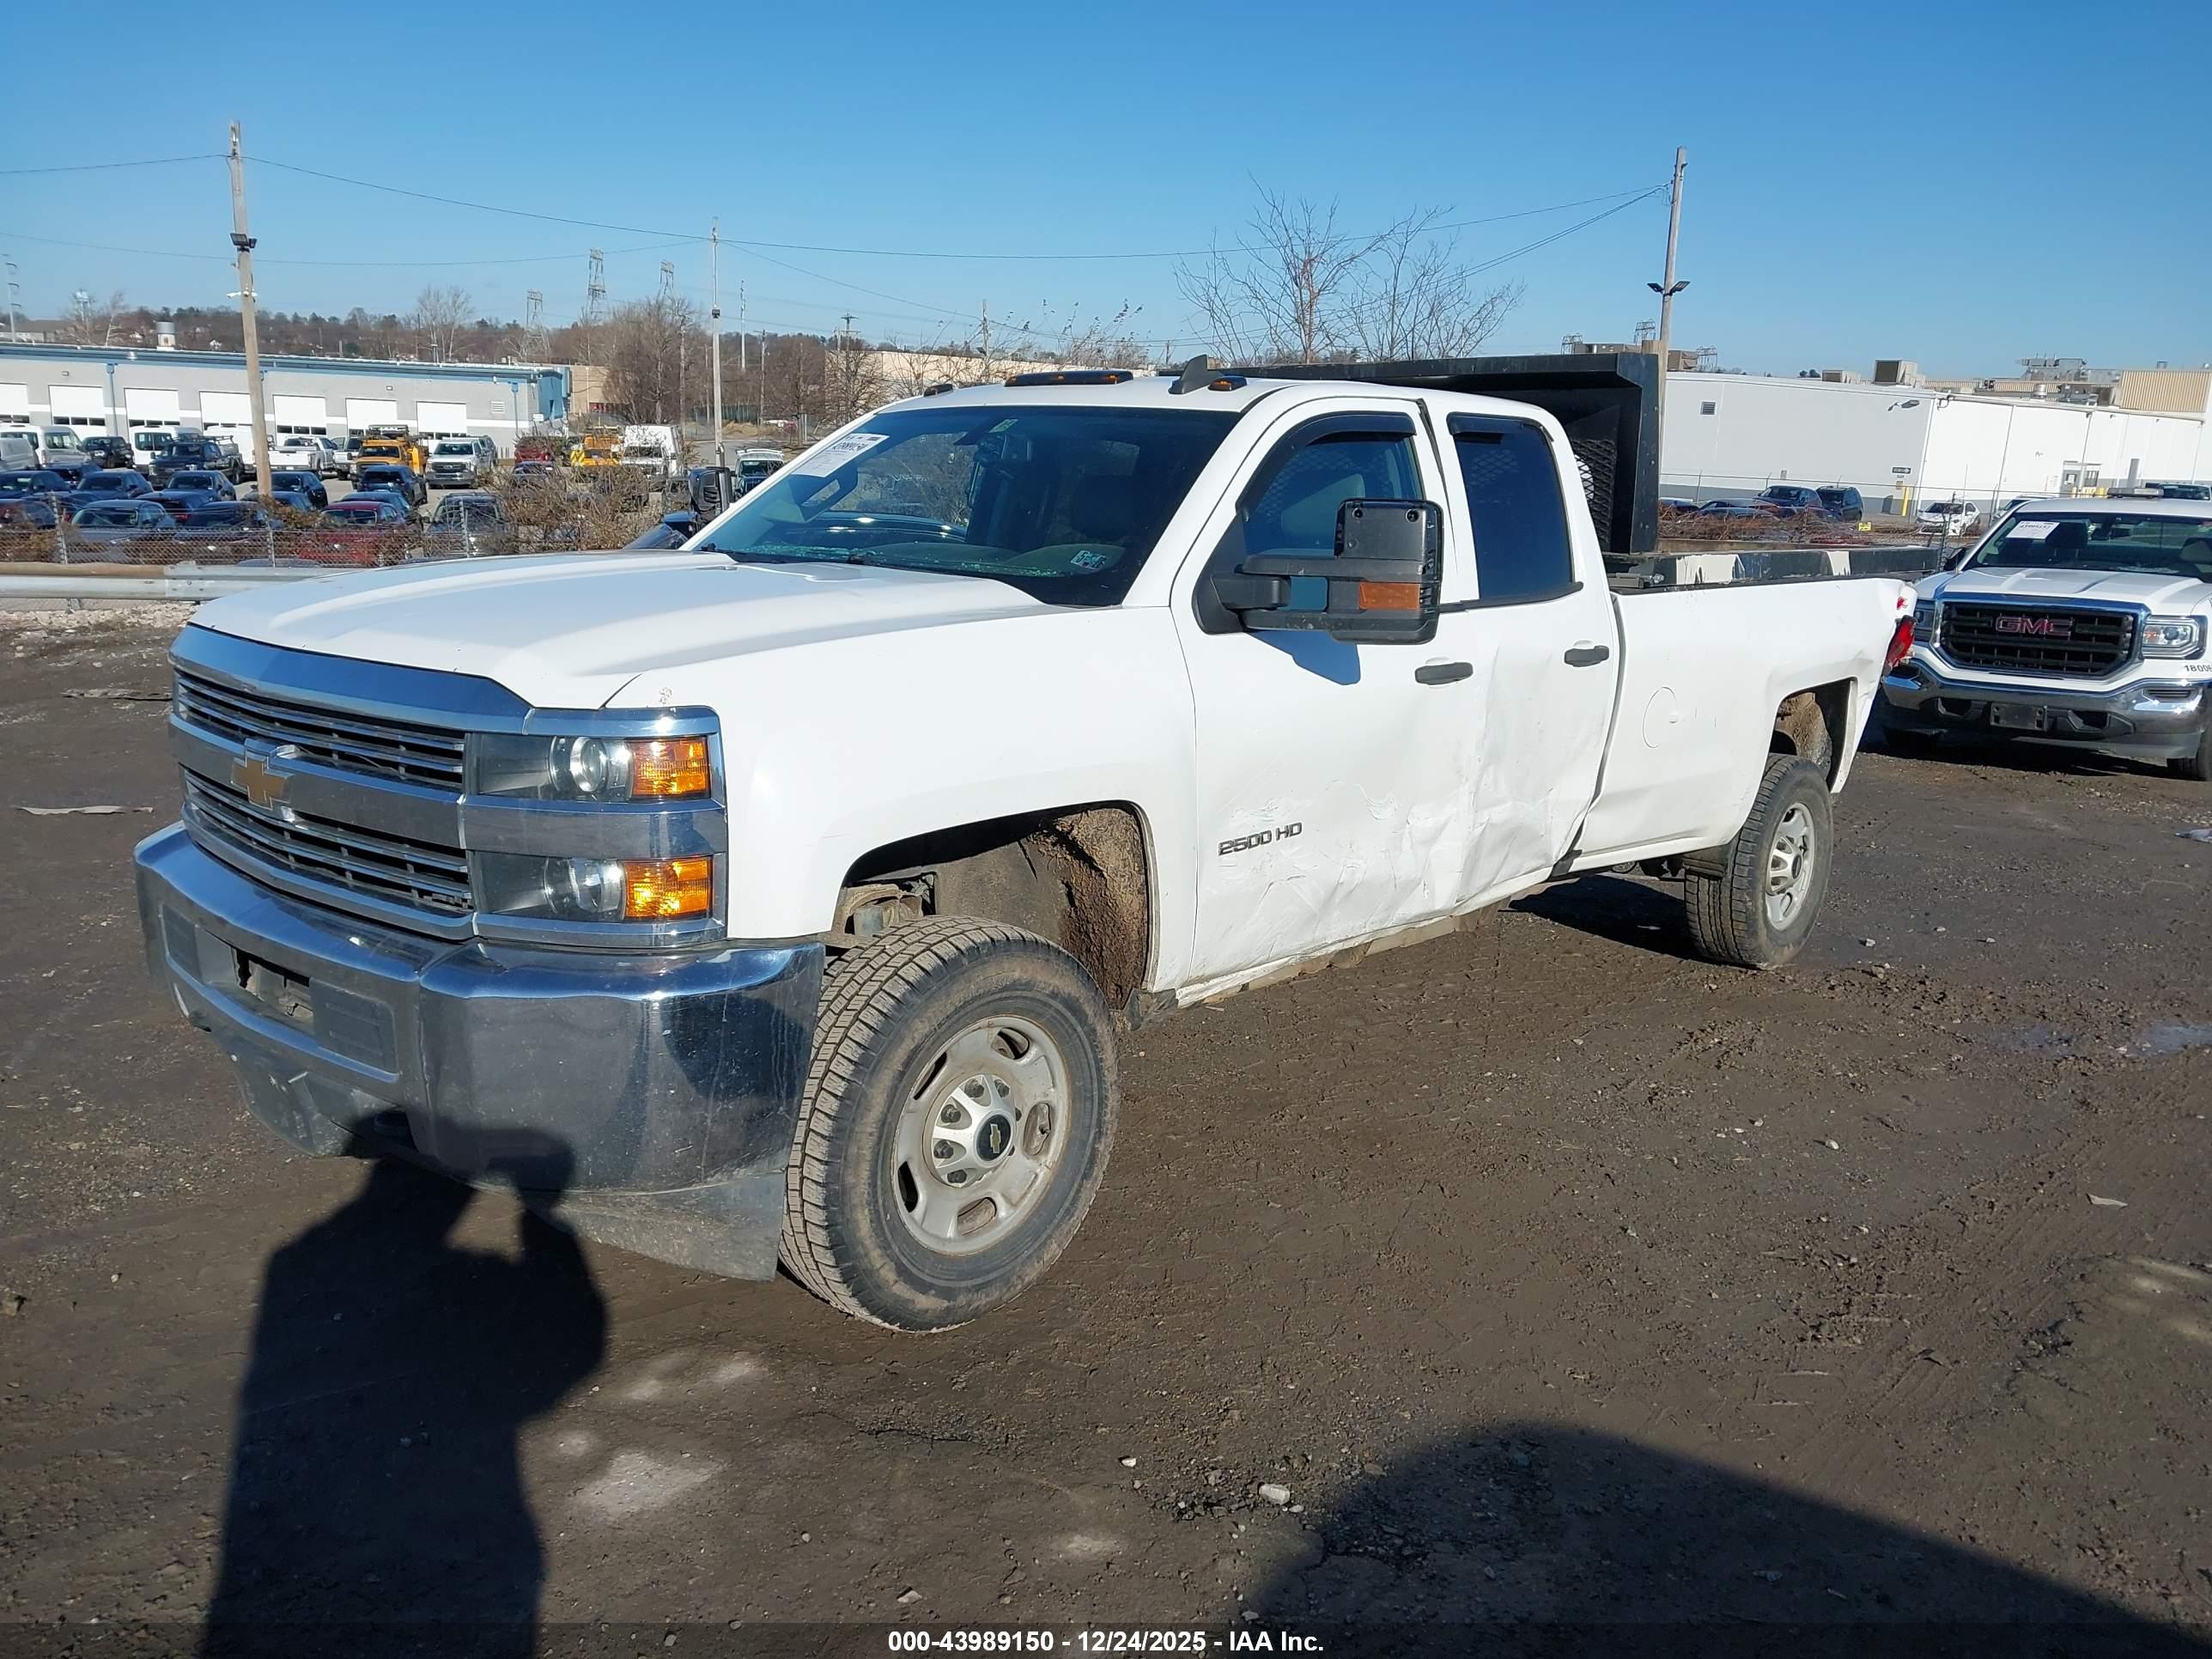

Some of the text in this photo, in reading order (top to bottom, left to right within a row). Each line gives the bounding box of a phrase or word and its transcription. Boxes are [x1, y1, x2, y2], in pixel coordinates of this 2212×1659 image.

[1996, 617, 2073, 636] GMC
[1218, 822, 1303, 856] 2500 HD
